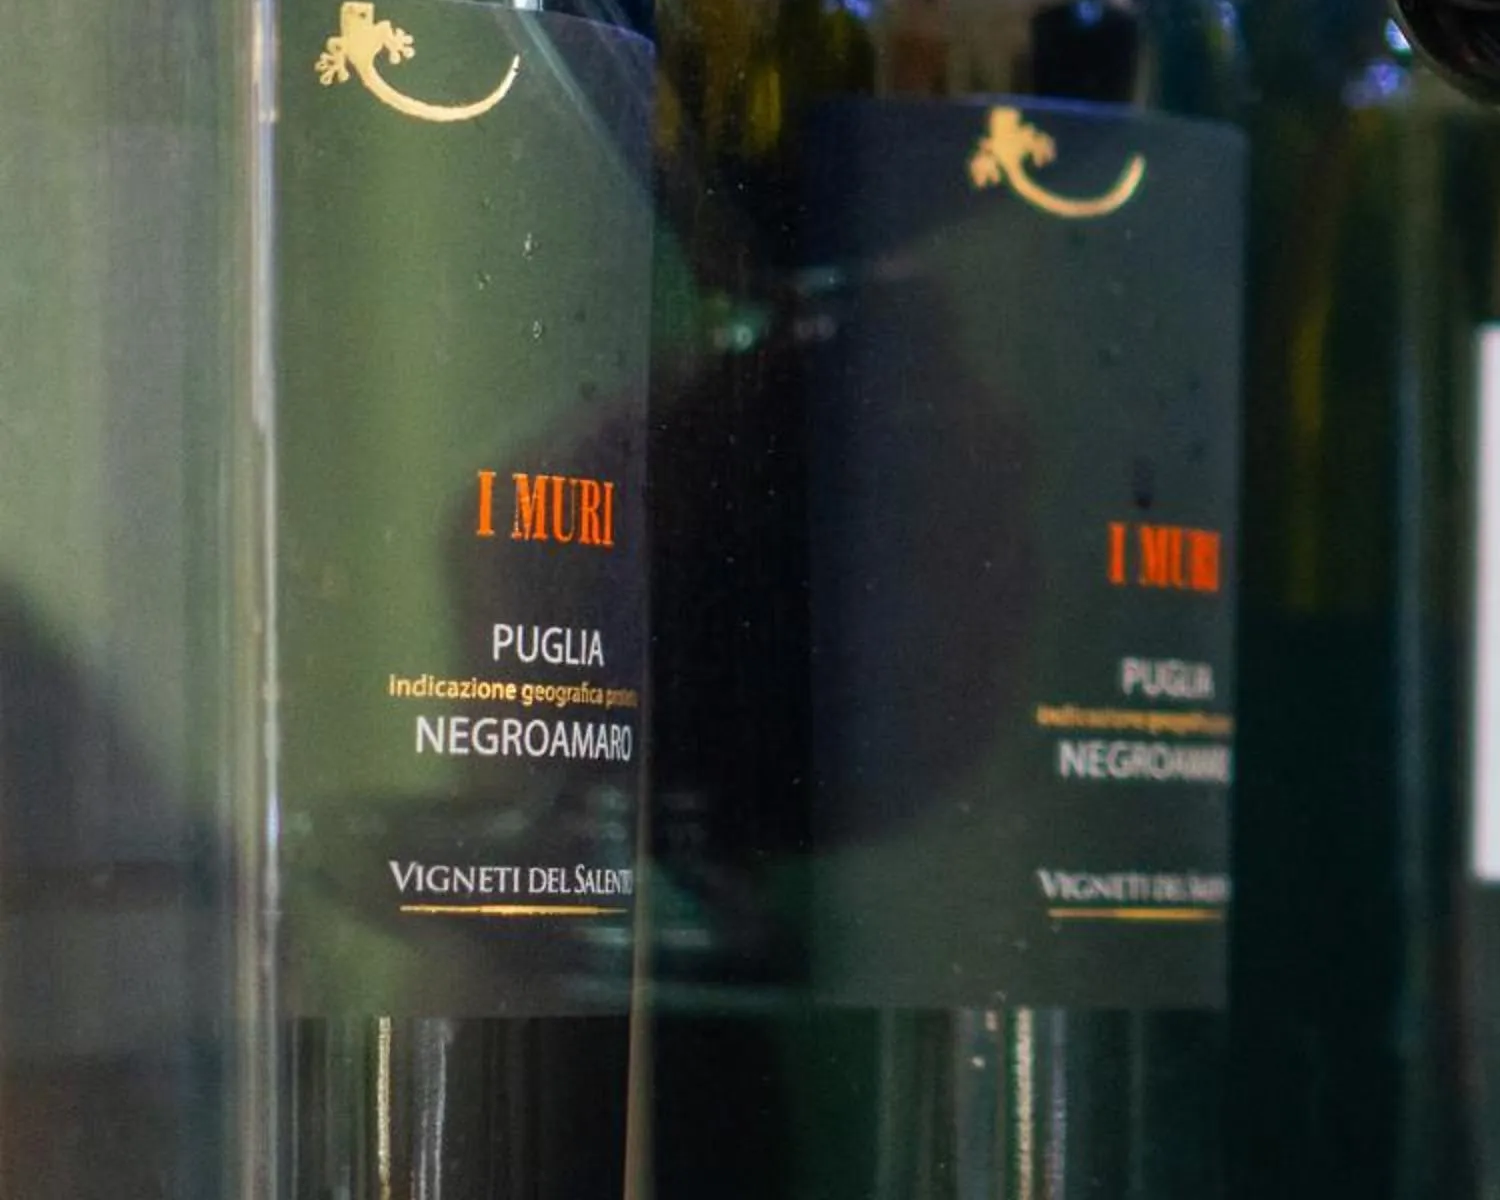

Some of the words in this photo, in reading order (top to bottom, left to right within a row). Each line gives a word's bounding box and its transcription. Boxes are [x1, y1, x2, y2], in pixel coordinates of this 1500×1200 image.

[477, 470, 496, 536] I
[511, 473, 615, 546] MURI
[492, 623, 605, 667] PUGLIA
[415, 715, 634, 761] NEGROAMARO
[388, 860, 521, 894] VIGNETI
[527, 866, 571, 894] DEL
